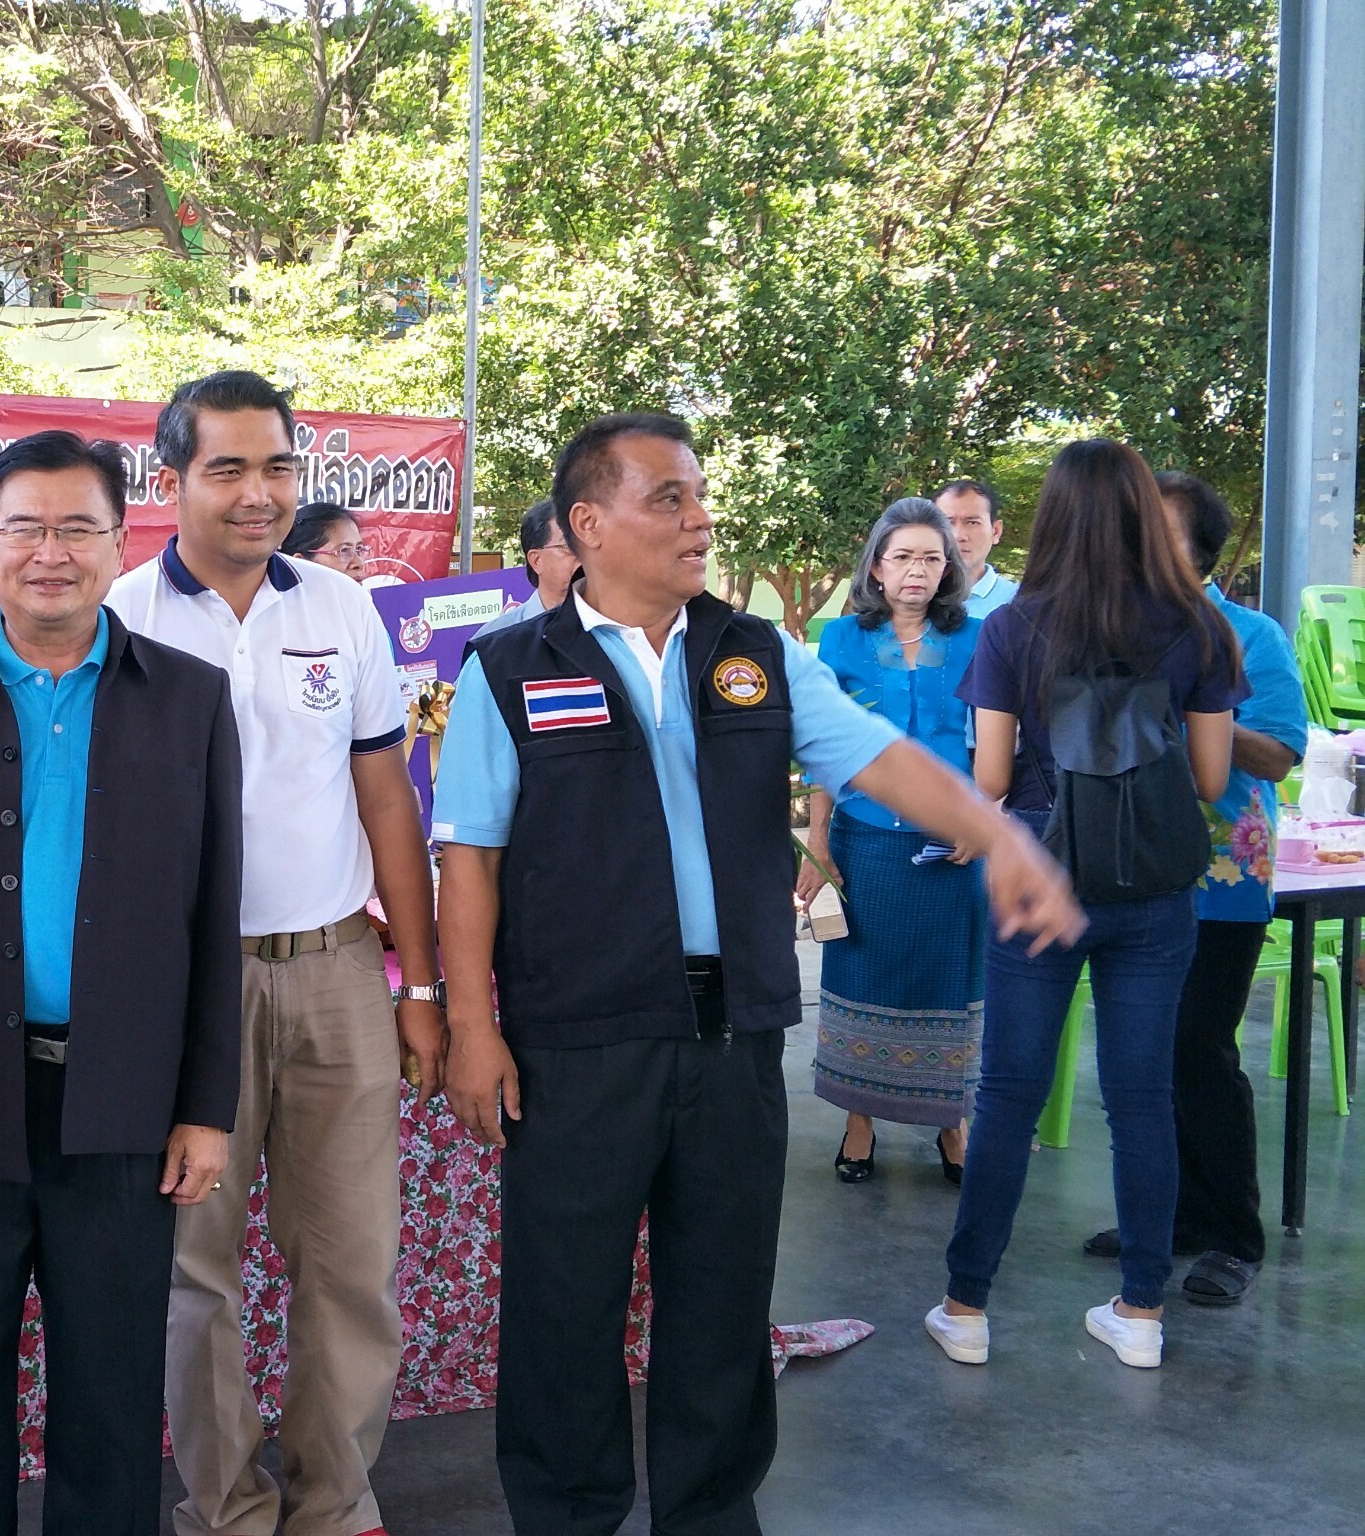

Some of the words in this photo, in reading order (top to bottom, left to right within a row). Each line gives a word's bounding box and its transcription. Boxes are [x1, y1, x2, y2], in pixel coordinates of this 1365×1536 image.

[428, 602, 501, 622] โรคไข้เลือดออก
